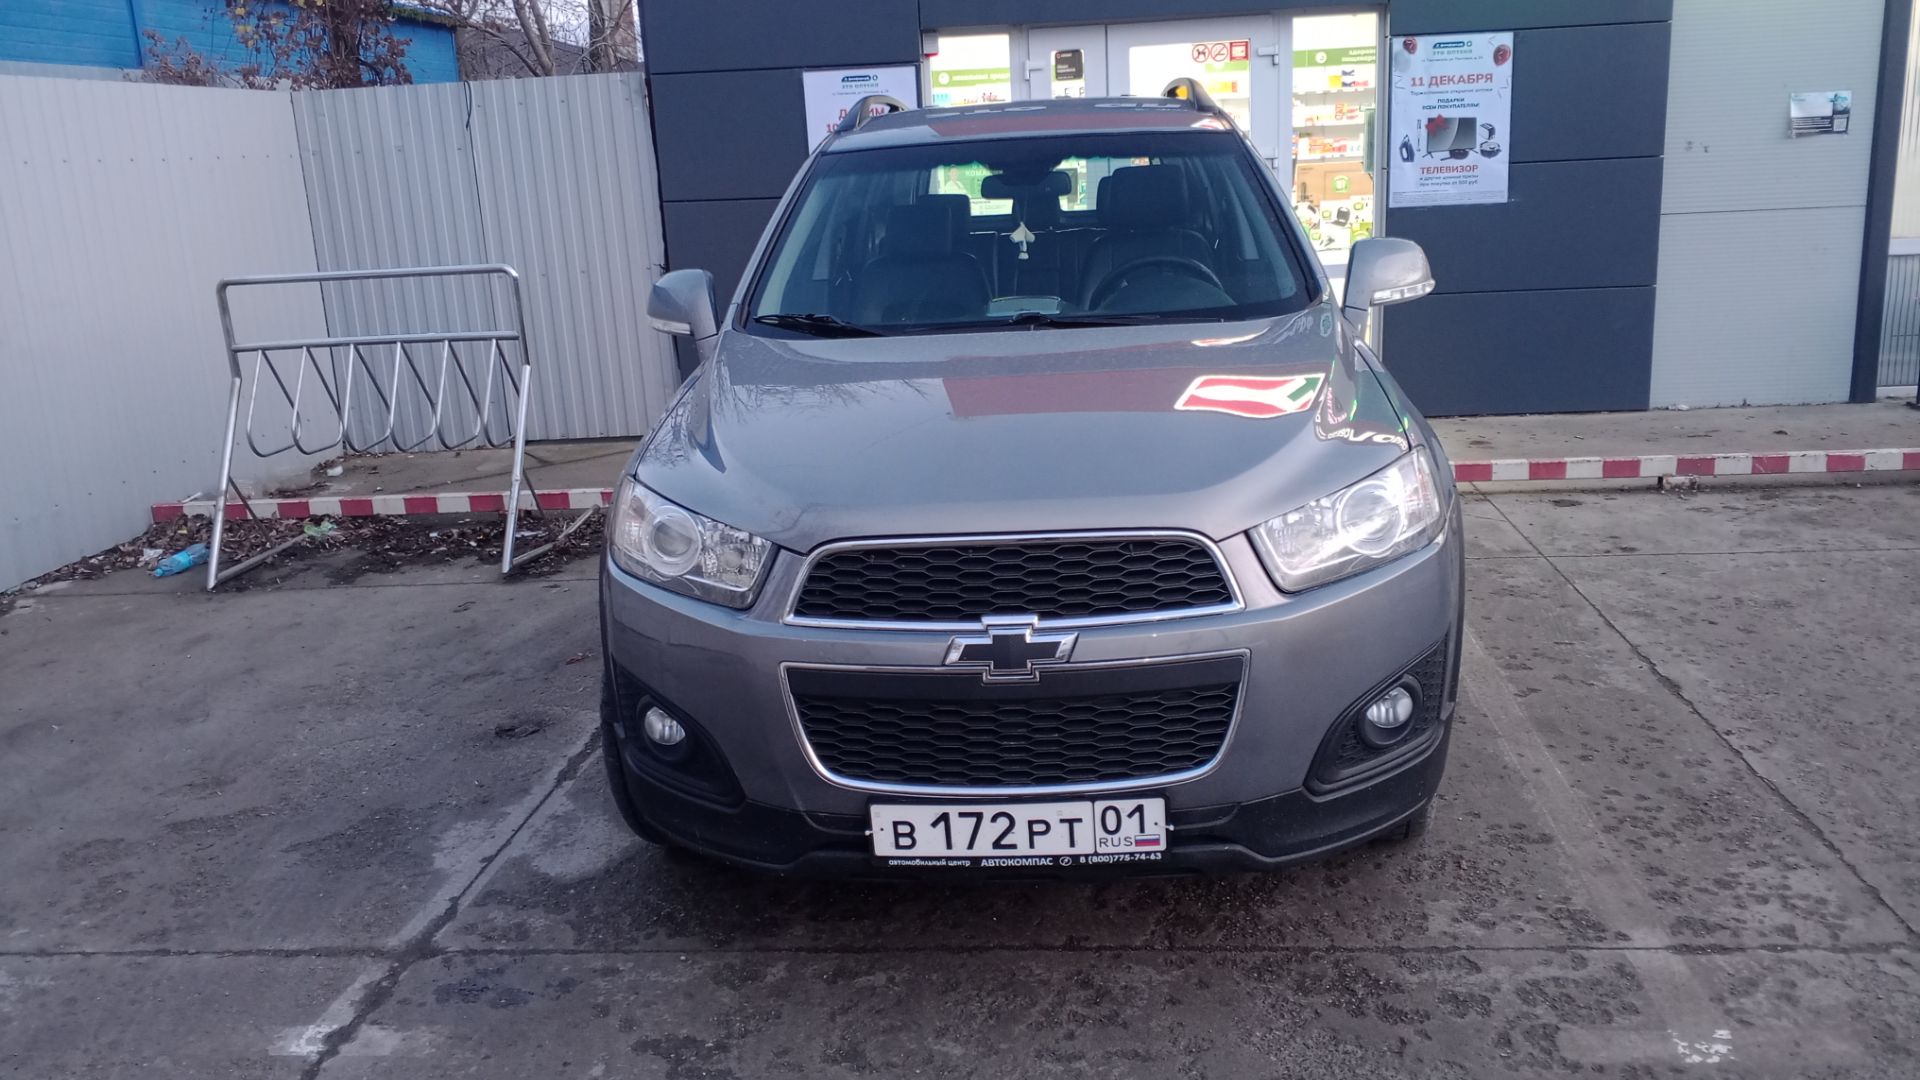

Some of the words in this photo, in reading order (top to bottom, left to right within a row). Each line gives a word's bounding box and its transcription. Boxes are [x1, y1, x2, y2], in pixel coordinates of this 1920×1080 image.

[1411, 77, 1425, 87] 11
[1428, 73, 1493, 88] ДЕКАБРЯ
[1419, 165, 1478, 175] ТЕЛЕВИЗОР
[1100, 803, 1145, 836] 01
[1099, 836, 1133, 848] RUS
[888, 858, 946, 867] автомобильный
[948, 859, 971, 868] центр
[980, 857, 1053, 867] АВТОКОМПАС
